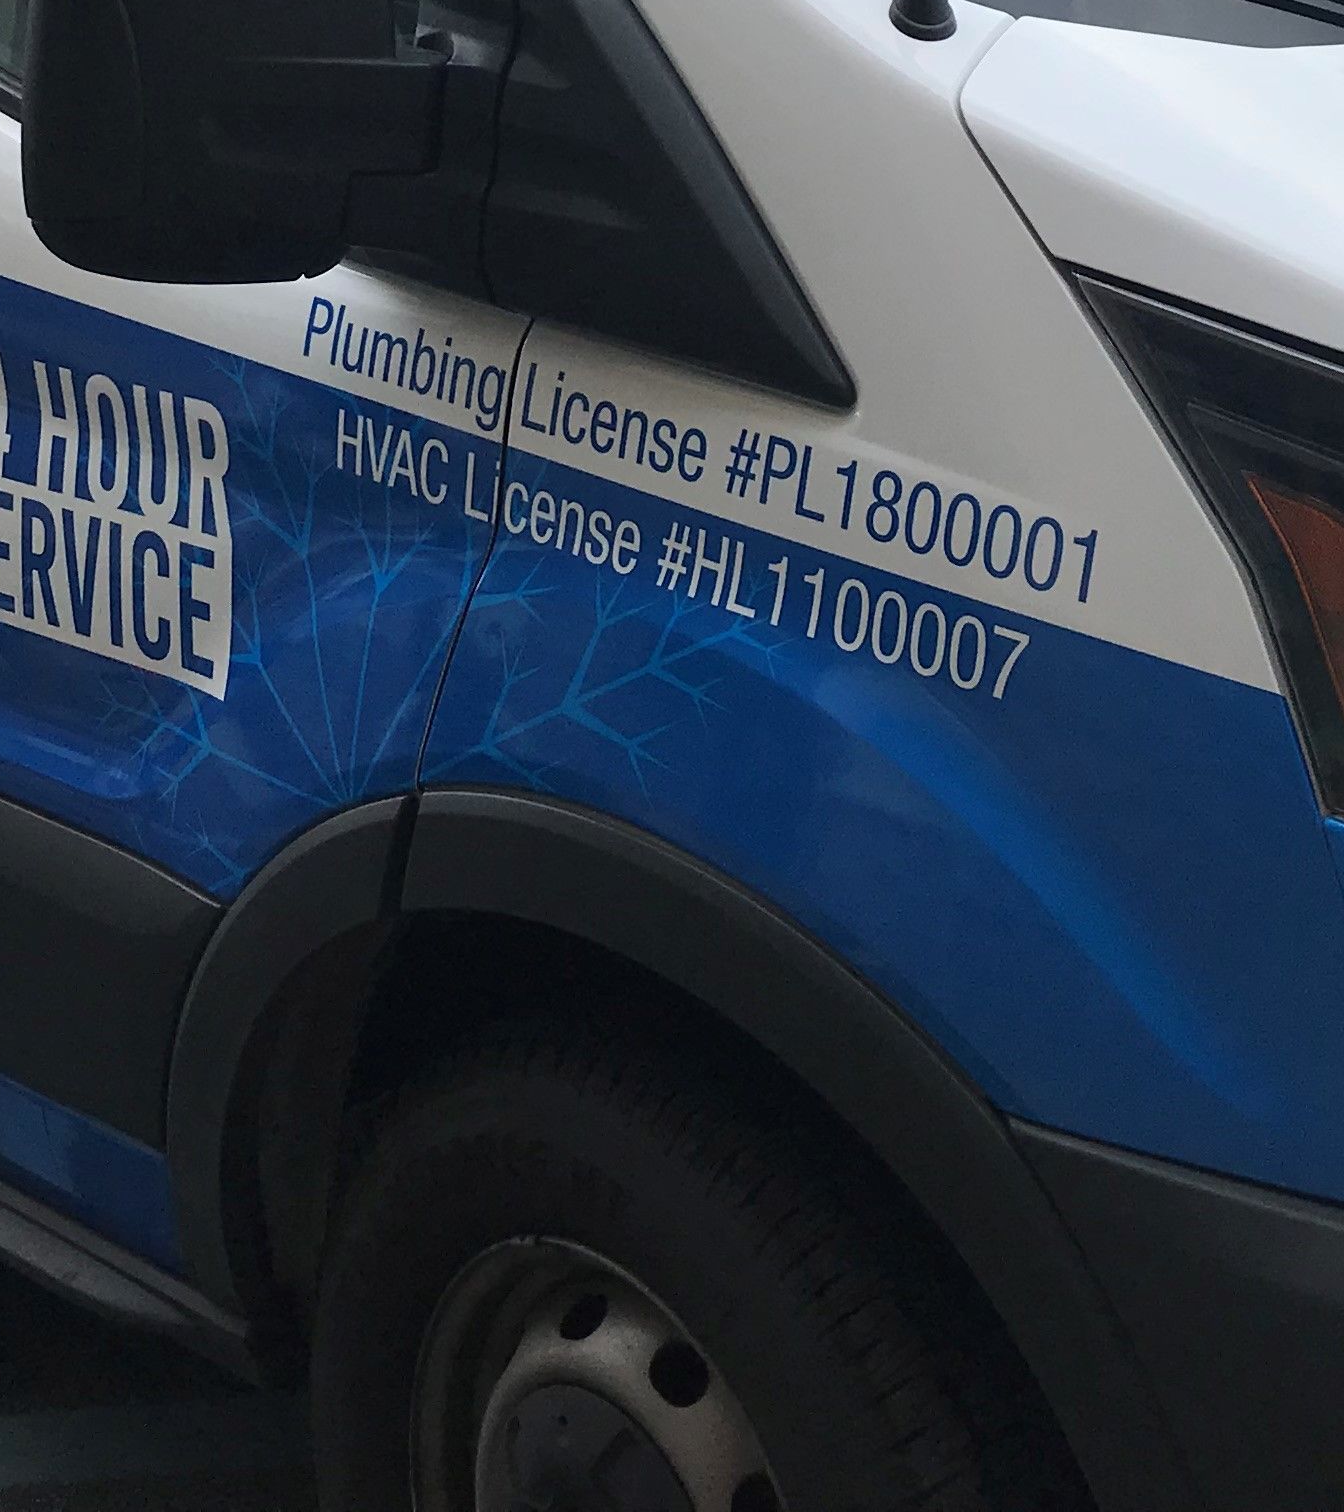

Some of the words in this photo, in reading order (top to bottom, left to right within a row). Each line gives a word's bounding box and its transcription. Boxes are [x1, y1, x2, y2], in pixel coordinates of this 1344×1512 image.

[30, 360, 232, 538] HOUR
[301, 296, 507, 432] Plumbing
[519, 362, 708, 483] License
[724, 428, 1099, 604] #PL1800001
[335, 408, 449, 505] HVAC
[465, 451, 643, 576] License
[655, 520, 1033, 701] #HL1100007
